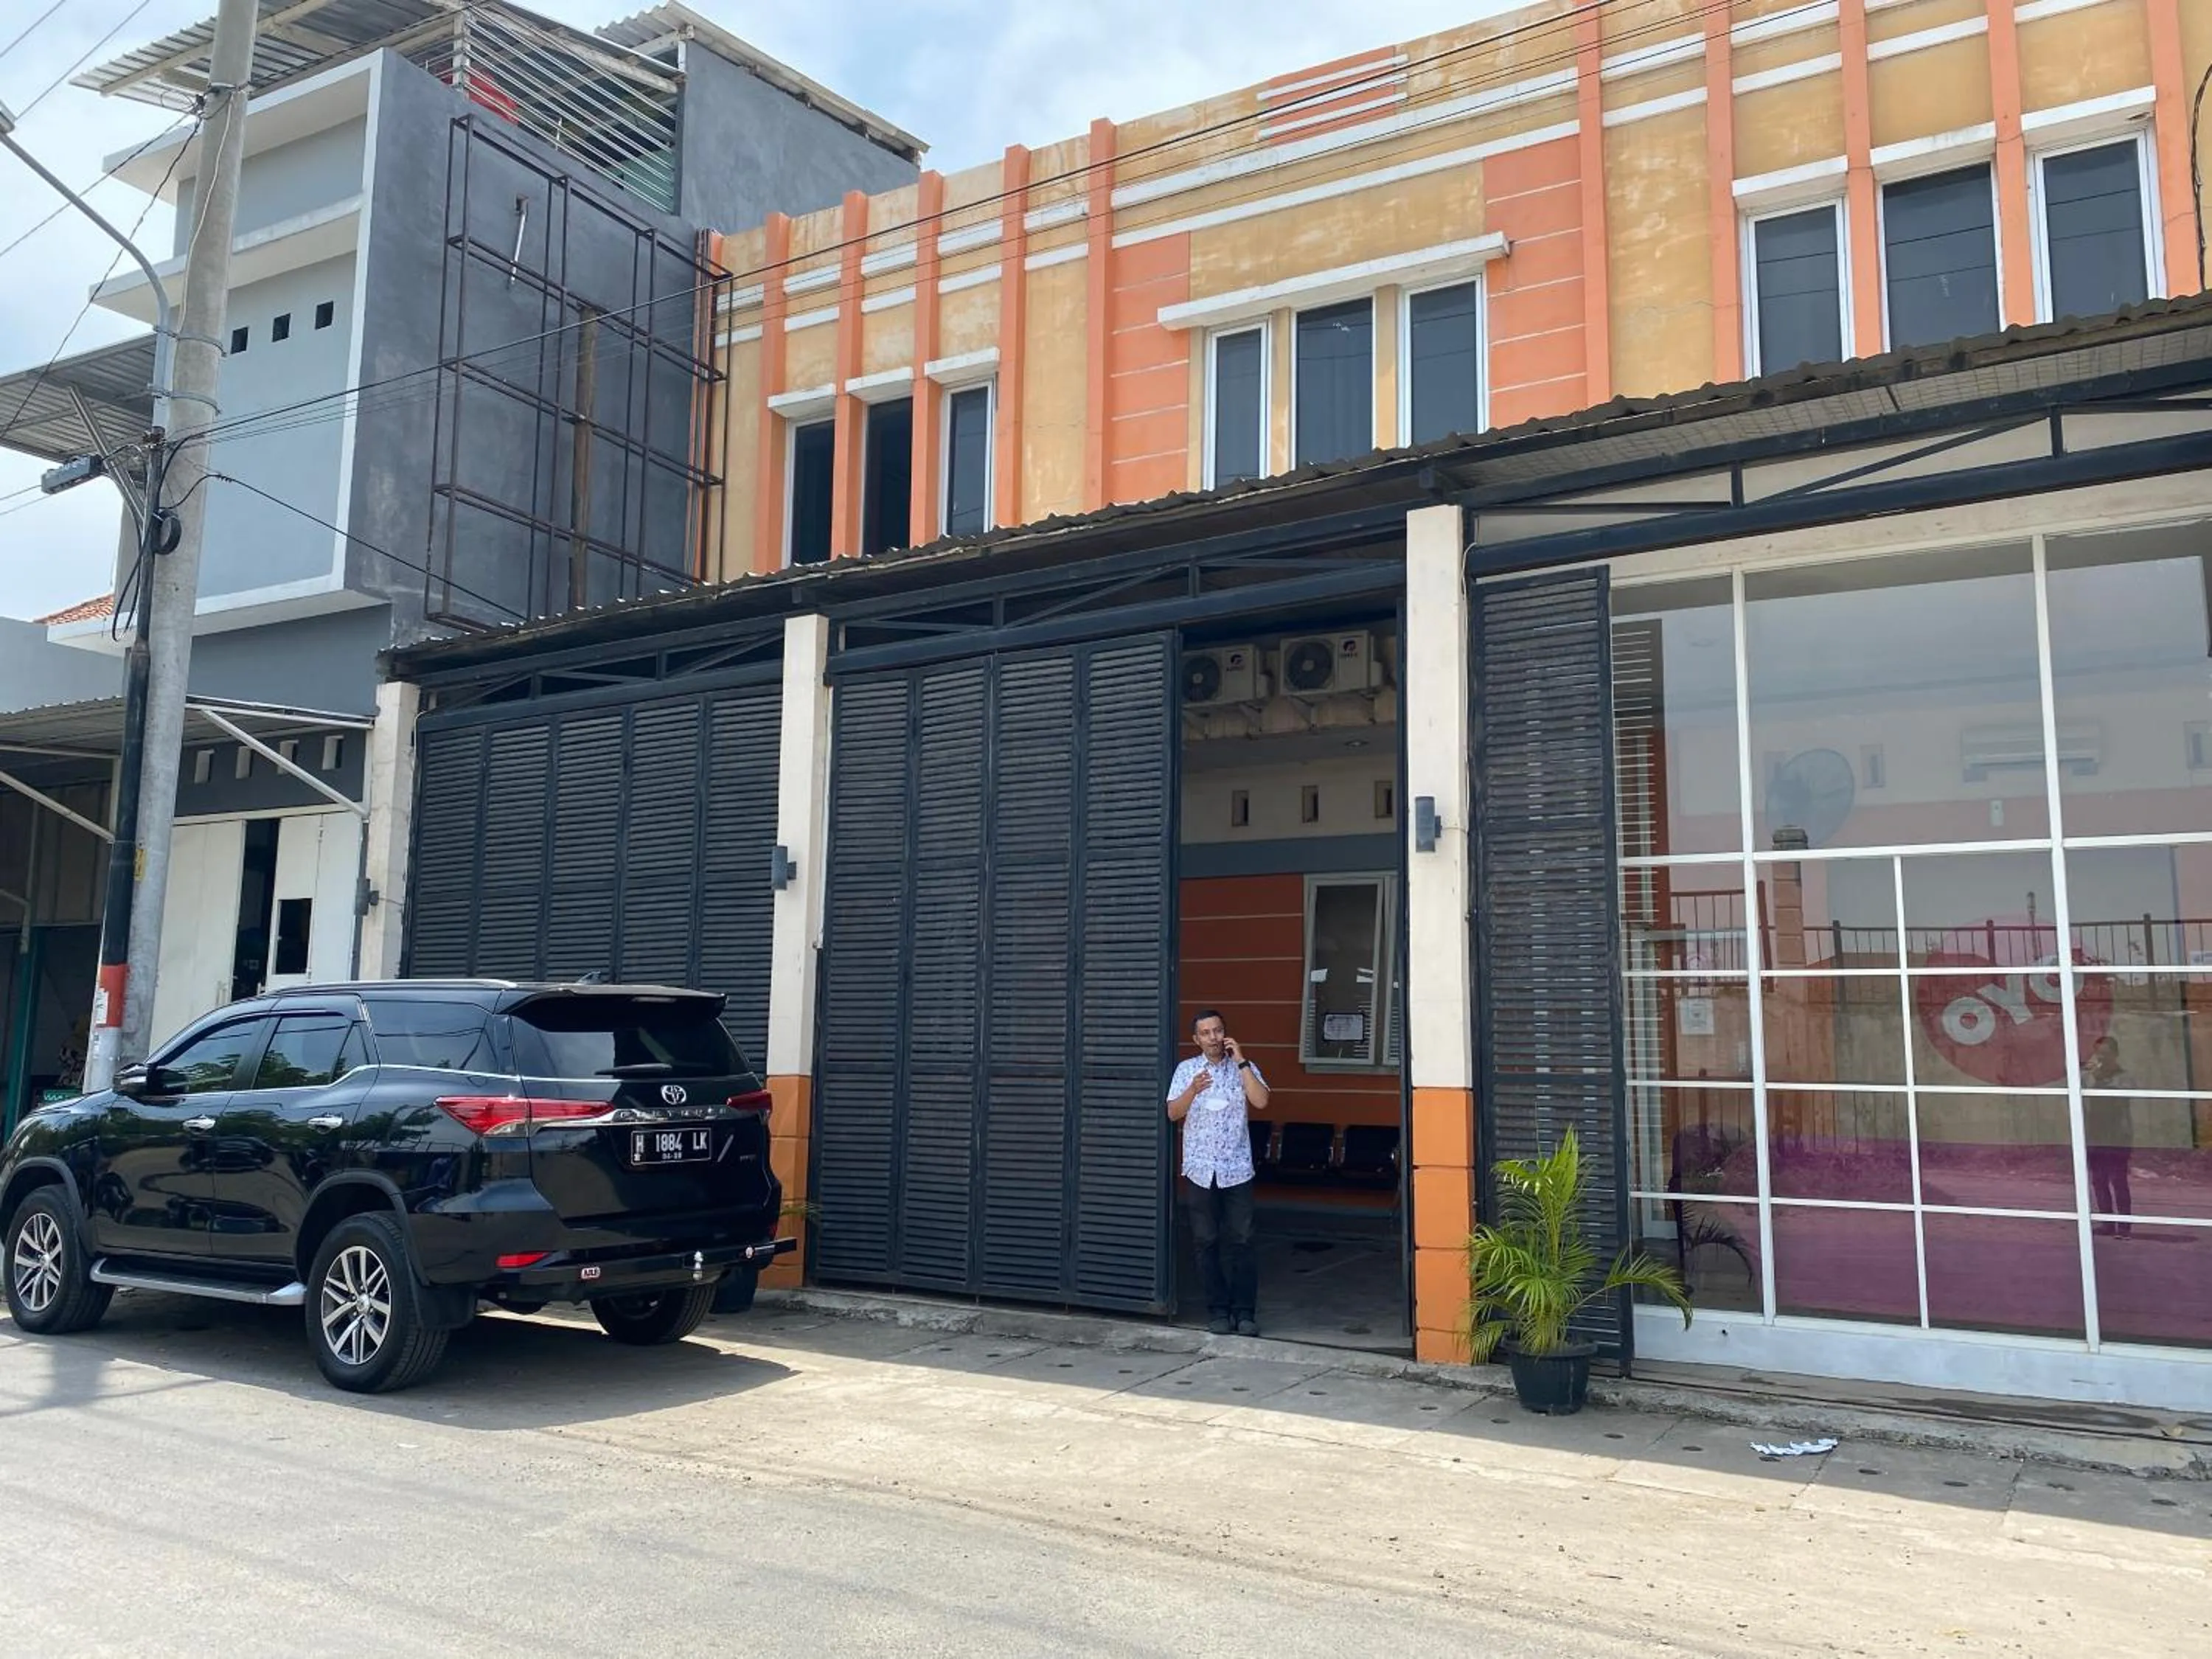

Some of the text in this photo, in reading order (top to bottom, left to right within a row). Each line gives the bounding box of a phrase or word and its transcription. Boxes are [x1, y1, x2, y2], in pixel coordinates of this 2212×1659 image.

[1941, 954, 2085, 1046] OYO
[636, 1135, 644, 1153] H
[693, 1132, 707, 1150] LK
